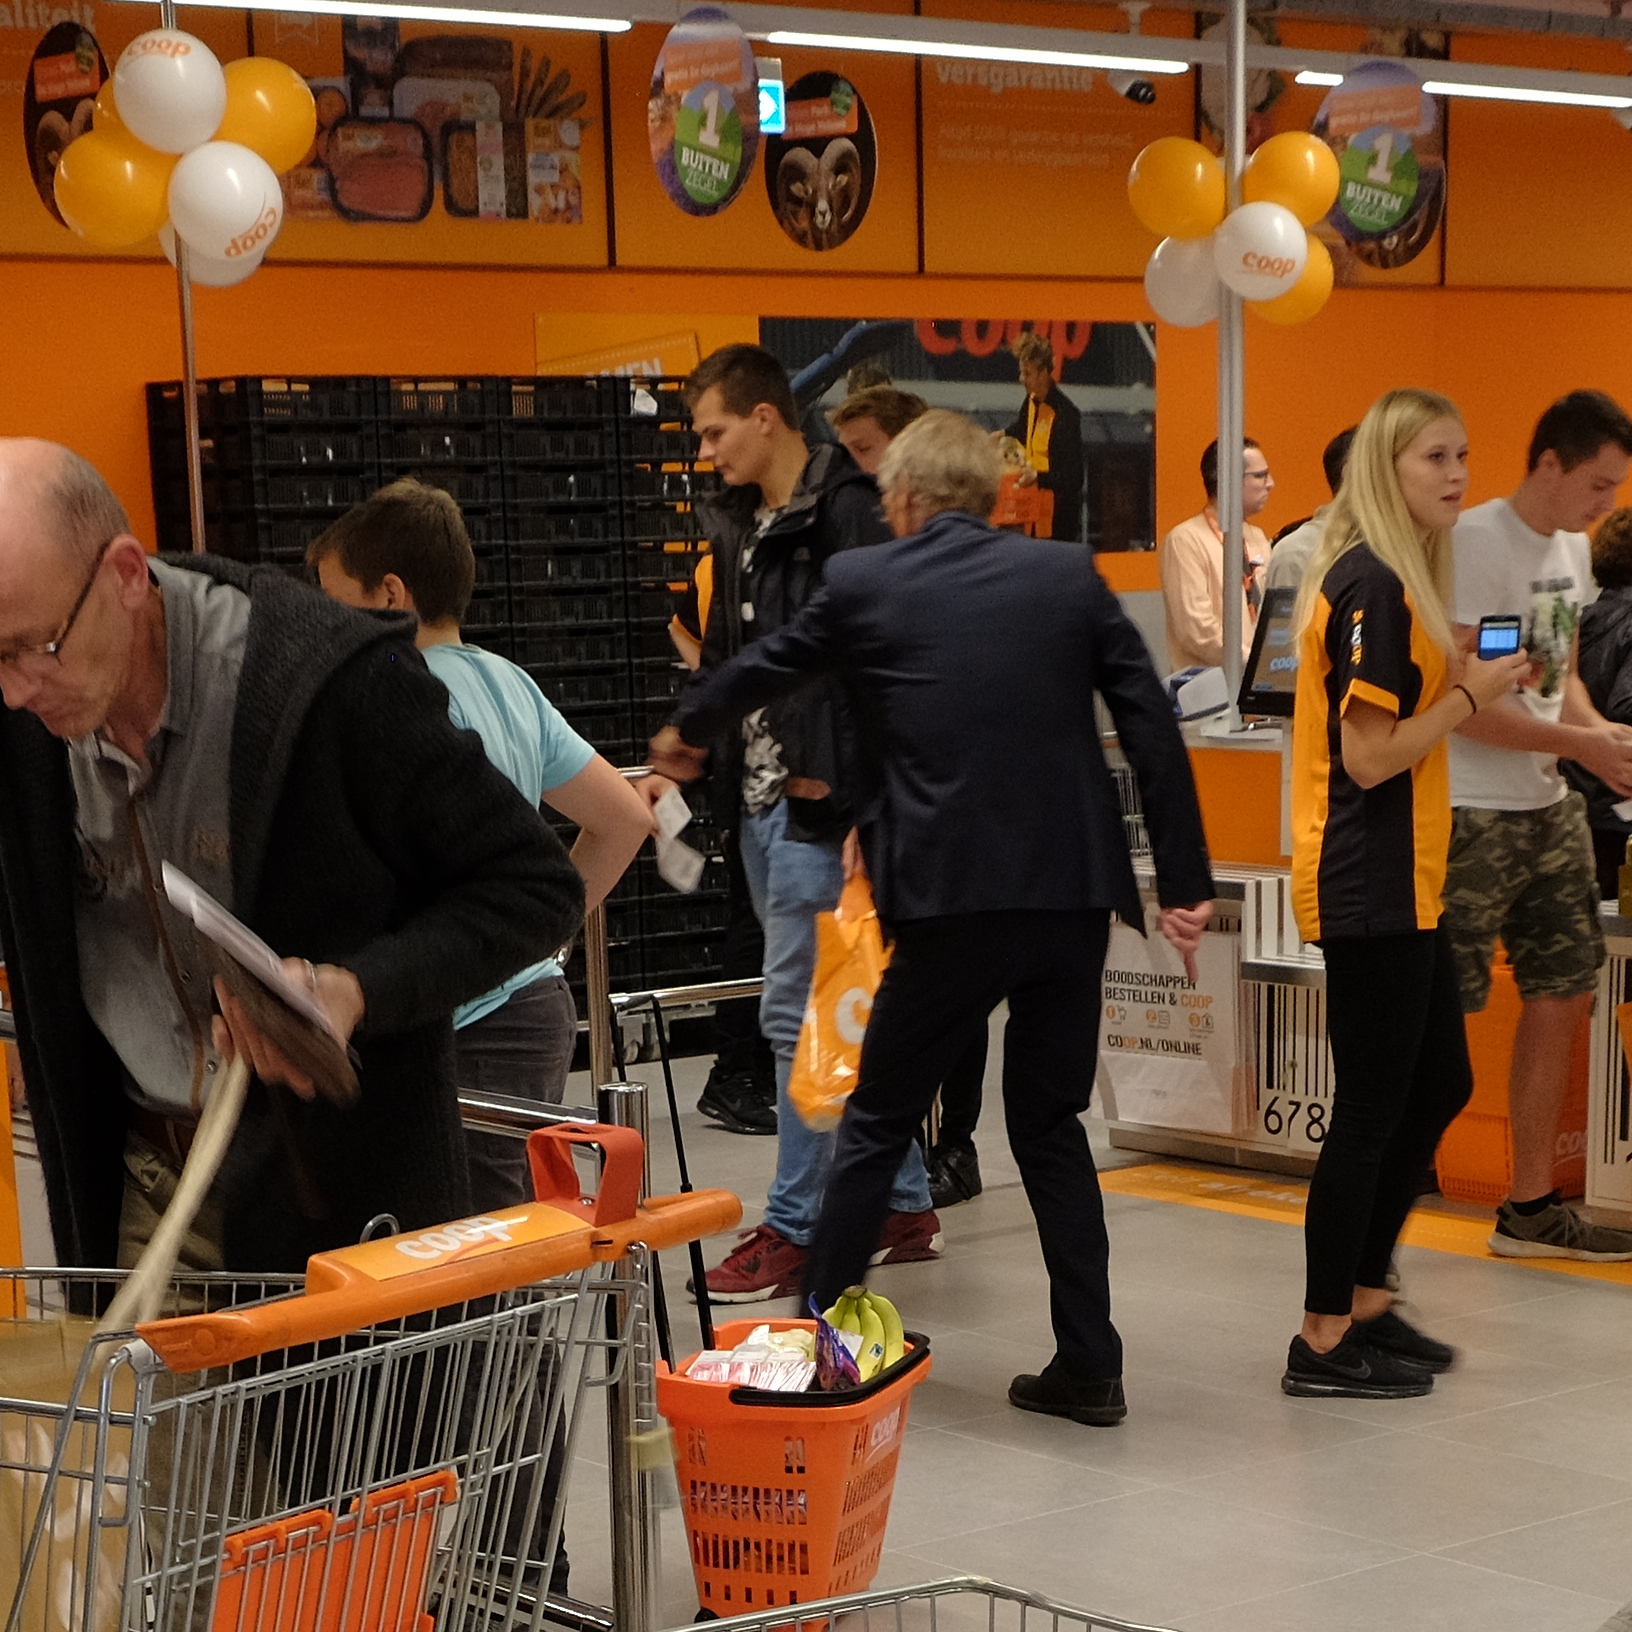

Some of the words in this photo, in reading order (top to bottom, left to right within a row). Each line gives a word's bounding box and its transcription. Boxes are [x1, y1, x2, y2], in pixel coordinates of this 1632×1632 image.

[698, 90, 720, 148] 1
[682, 146, 730, 181] BUITEN
[1367, 131, 1394, 185] 1
[1346, 181, 1403, 212] BUITEN
[224, 206, 278, 260] coop
[1242, 250, 1296, 279] coop
[1104, 969, 1197, 991] BOODSCHAPPEN
[1104, 986, 1166, 1006] BESTELLEN
[1169, 993, 1178, 1007] &
[1181, 996, 1213, 1010] COOP
[1106, 1033, 1203, 1056] COOP.NL/ONLINE
[394, 1216, 513, 1261] coop
